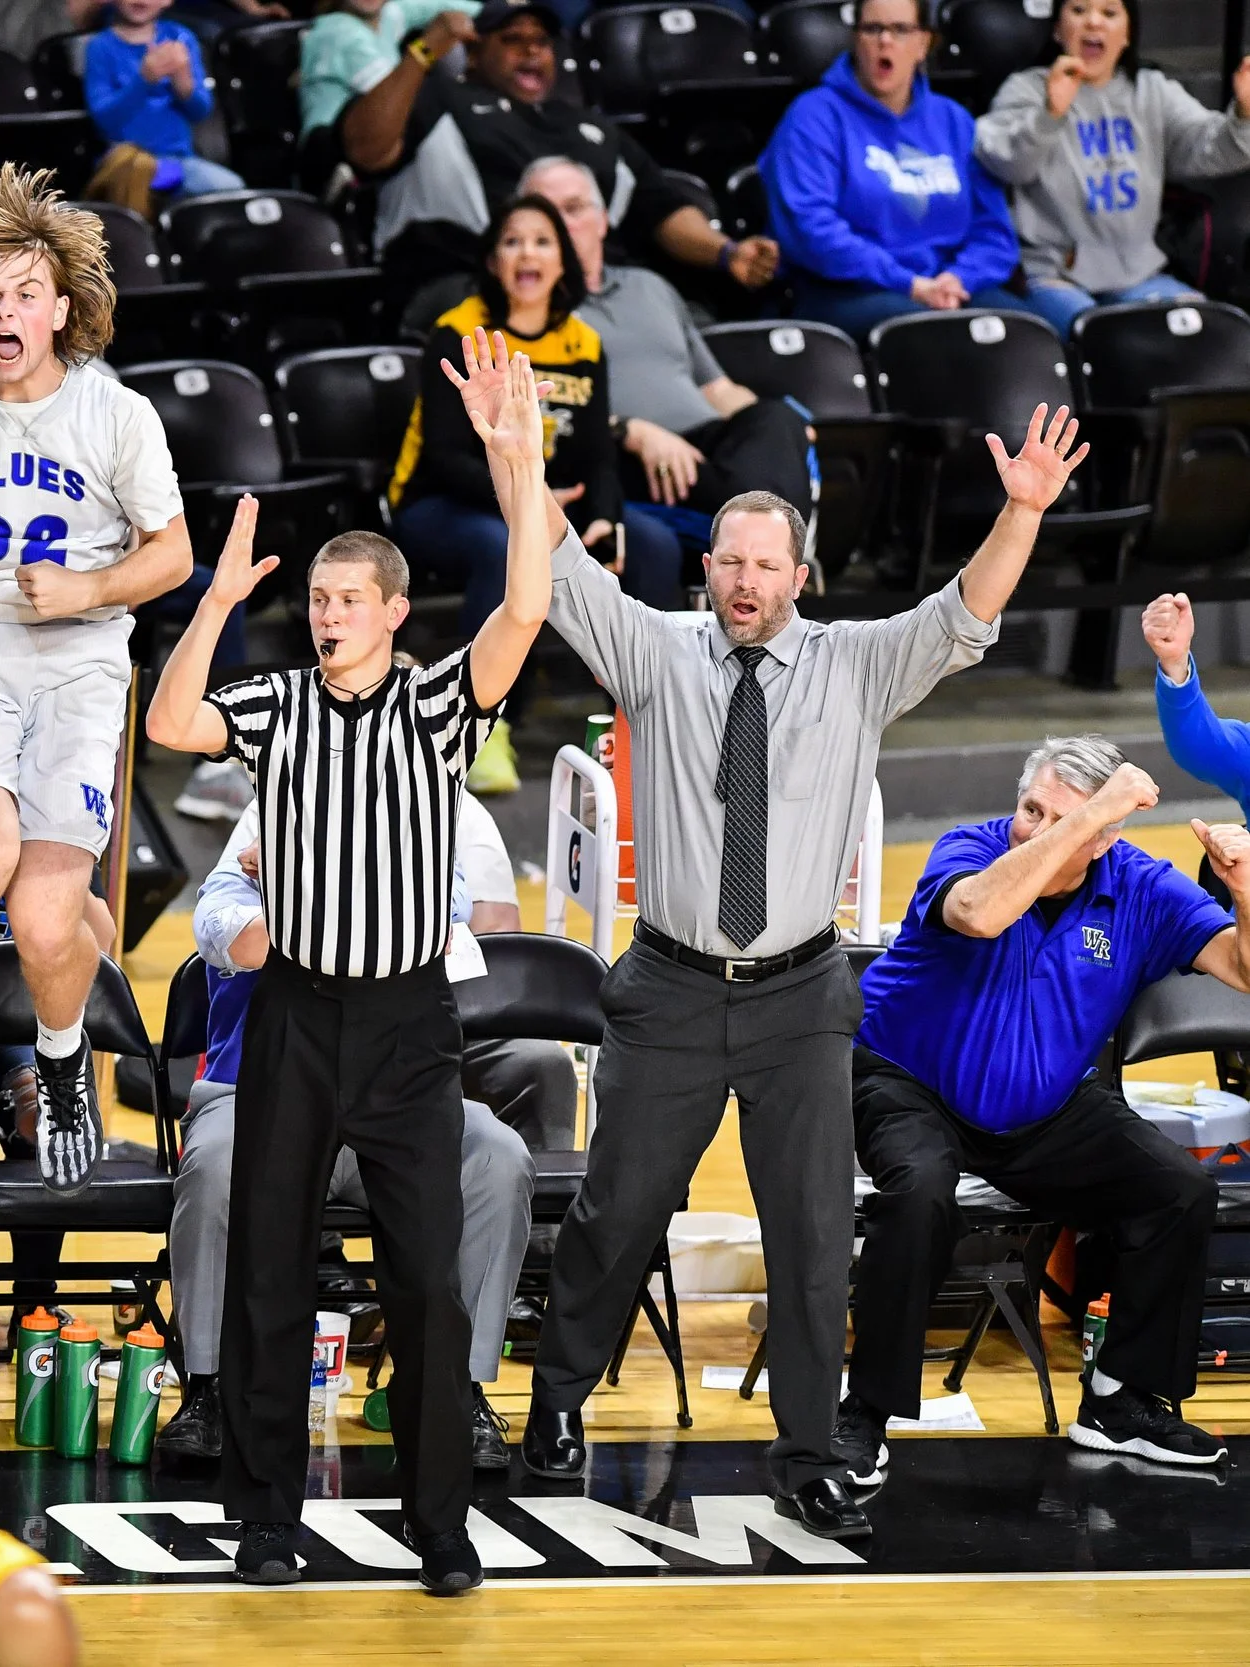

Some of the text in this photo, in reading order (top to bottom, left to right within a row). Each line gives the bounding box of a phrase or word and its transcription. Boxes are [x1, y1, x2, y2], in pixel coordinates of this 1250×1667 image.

[1076, 115, 1136, 156] WR
[1086, 170, 1138, 215] HS
[1082, 926, 1111, 960] WR
[28, 1347, 53, 1378] G
[1083, 1332, 1094, 1362] G
